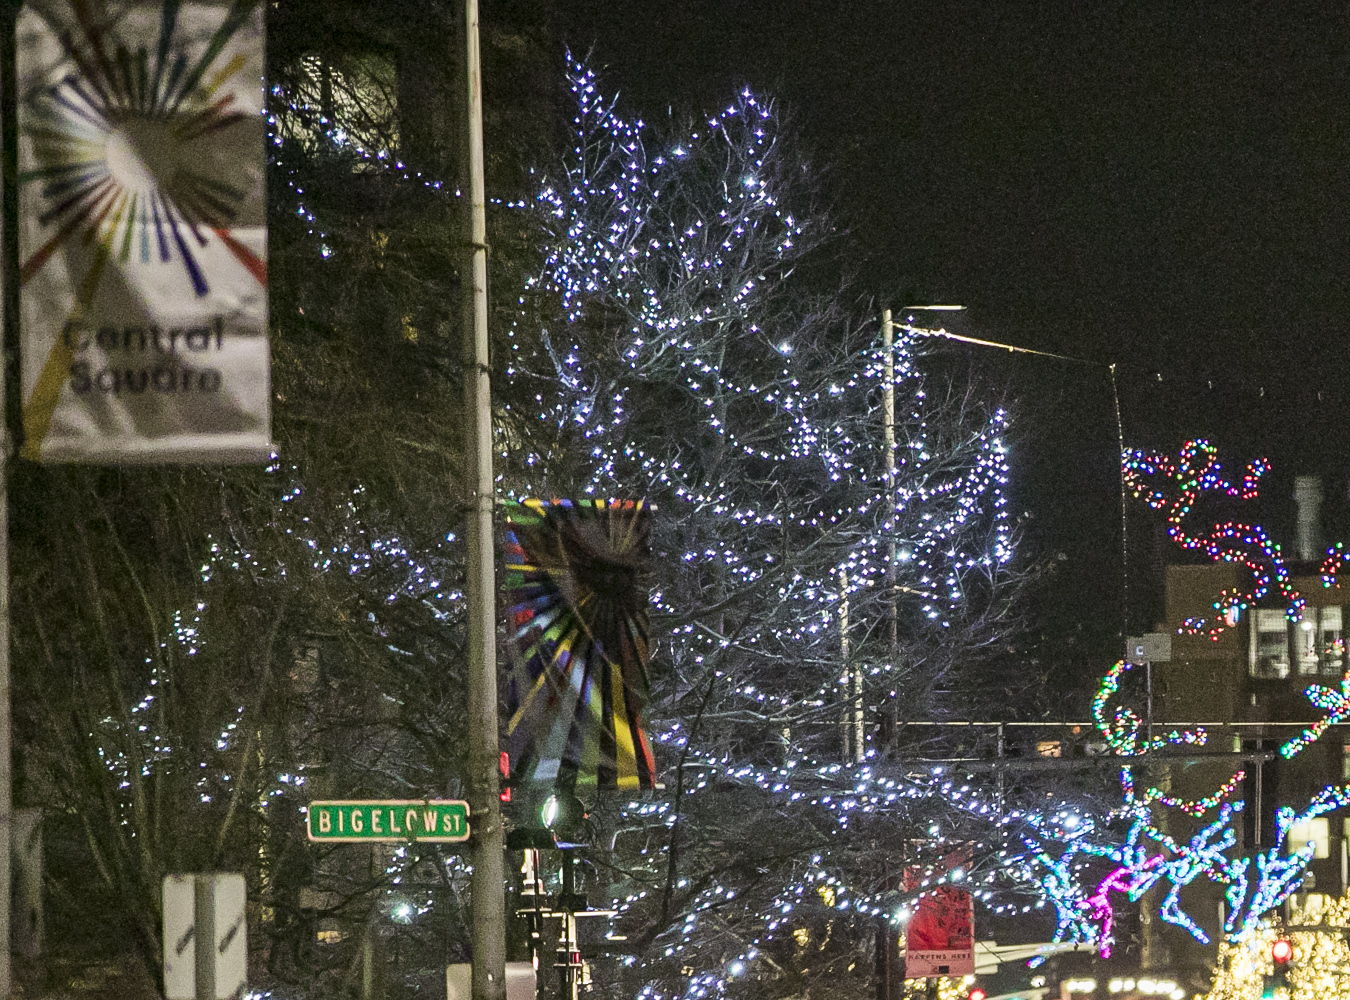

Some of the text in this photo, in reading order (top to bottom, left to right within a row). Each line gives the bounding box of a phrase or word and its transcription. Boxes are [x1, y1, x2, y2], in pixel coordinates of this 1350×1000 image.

[63, 322, 224, 350] Central
[70, 361, 222, 395] Square
[319, 809, 460, 832] BIGELOW ST
